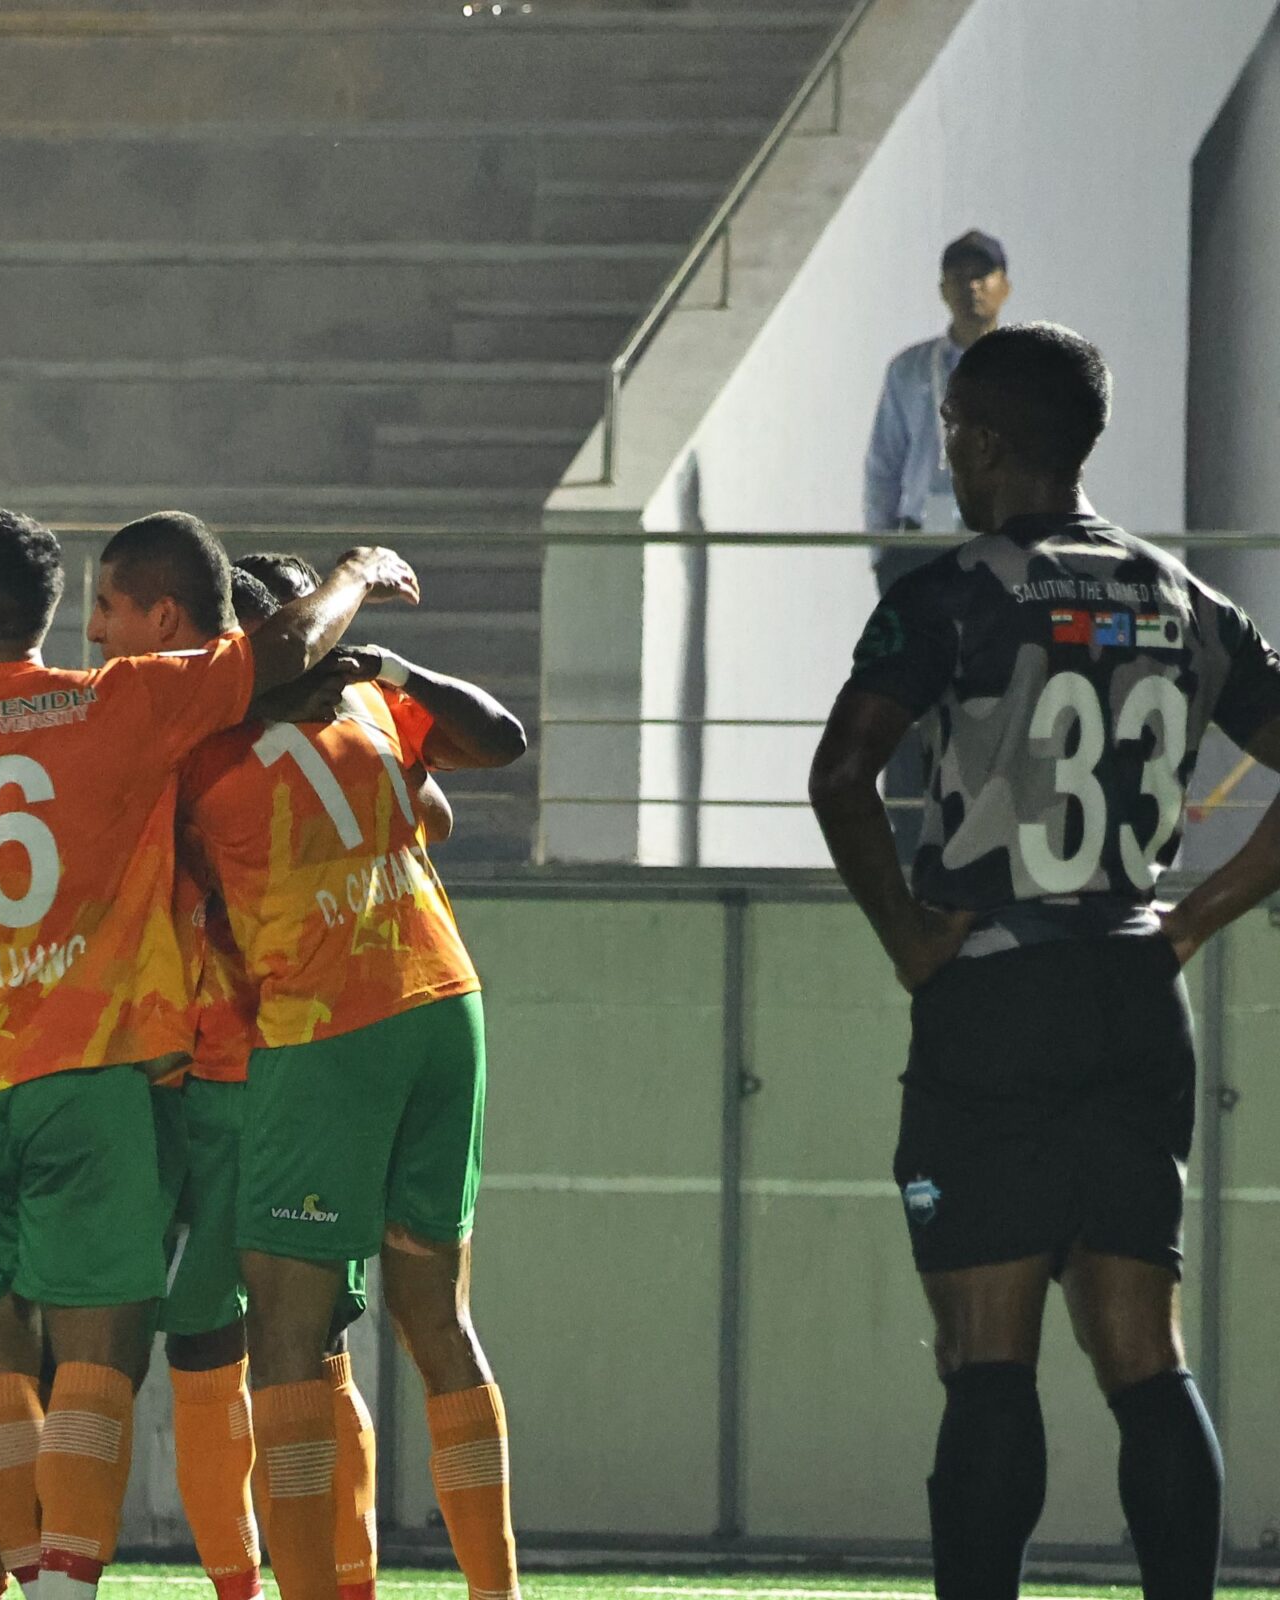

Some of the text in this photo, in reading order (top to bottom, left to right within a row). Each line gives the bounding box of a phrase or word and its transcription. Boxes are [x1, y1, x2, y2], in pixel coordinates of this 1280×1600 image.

[1013, 579, 1077, 603] SALUTING
[1078, 580, 1103, 601] THE
[1019, 671, 1188, 893] 33
[271, 1207, 339, 1223] VALLION
